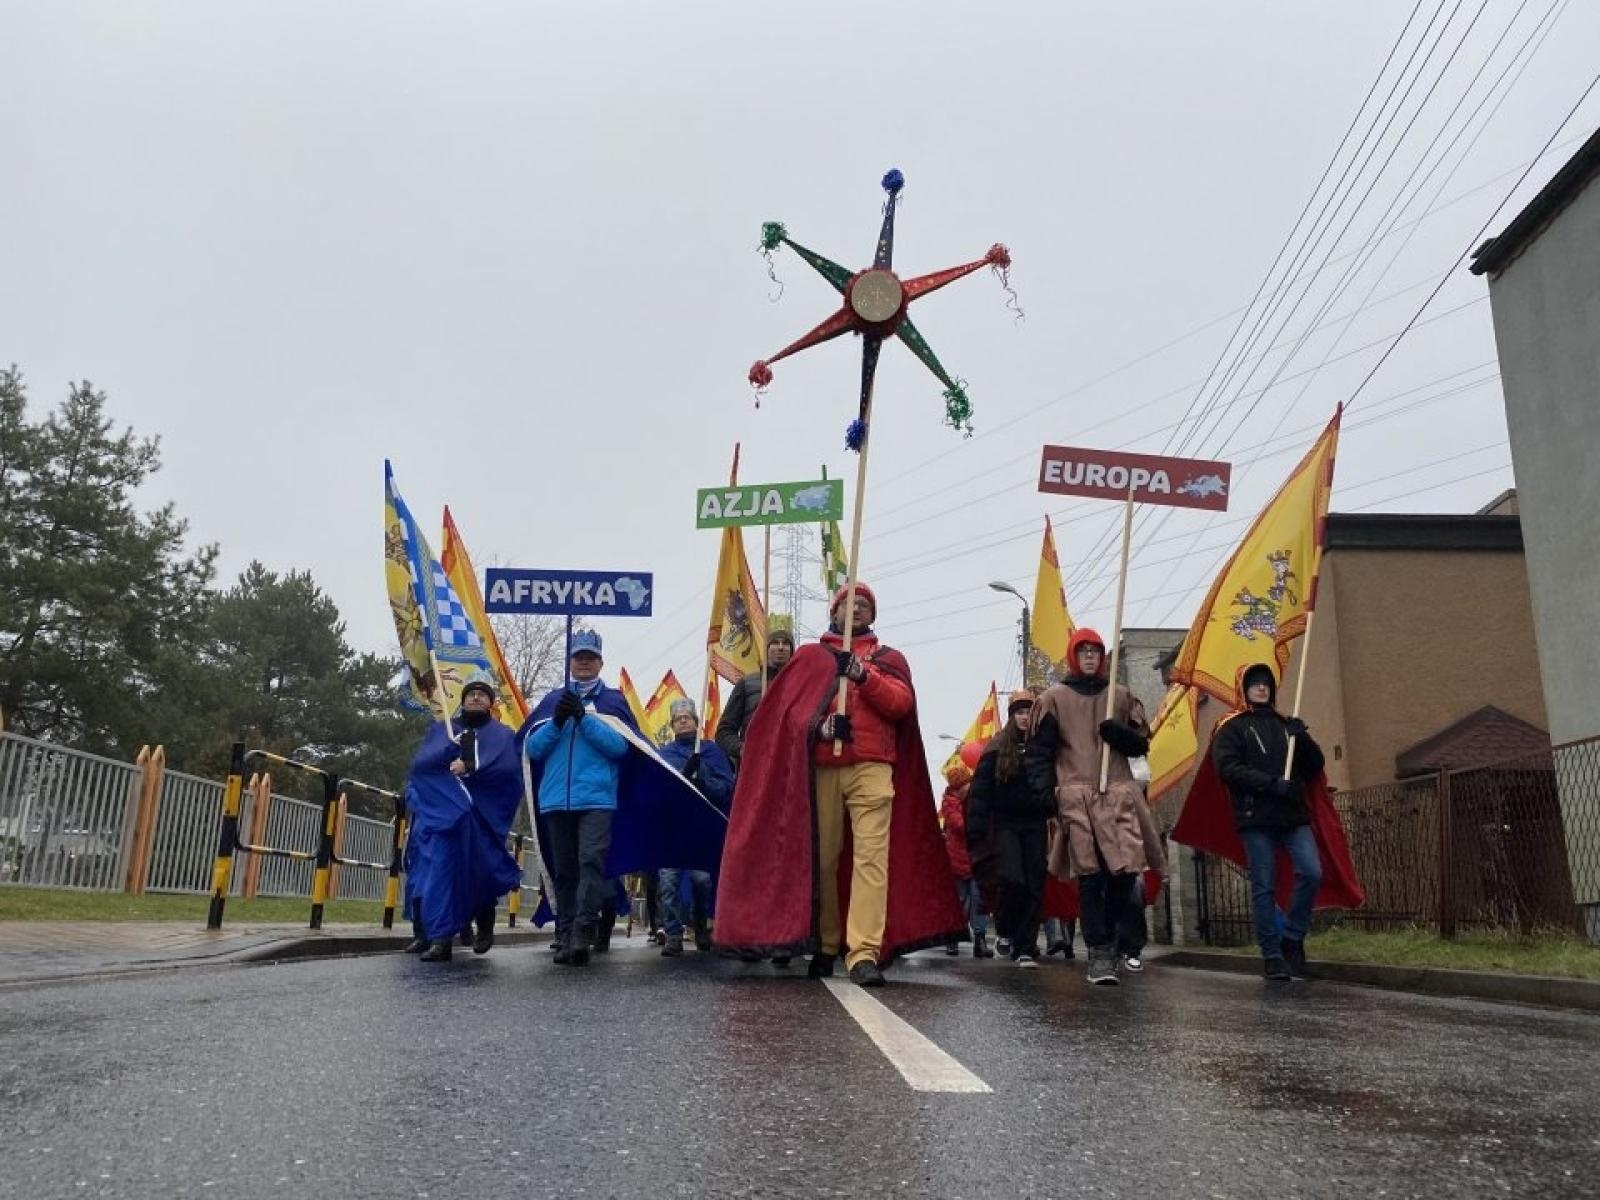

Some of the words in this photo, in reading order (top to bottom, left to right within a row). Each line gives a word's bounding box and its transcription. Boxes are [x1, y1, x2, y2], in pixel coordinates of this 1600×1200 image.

[1044, 459, 1171, 494] EUROPA
[700, 489, 784, 519] AZJA
[489, 579, 616, 606] AFRYKA
